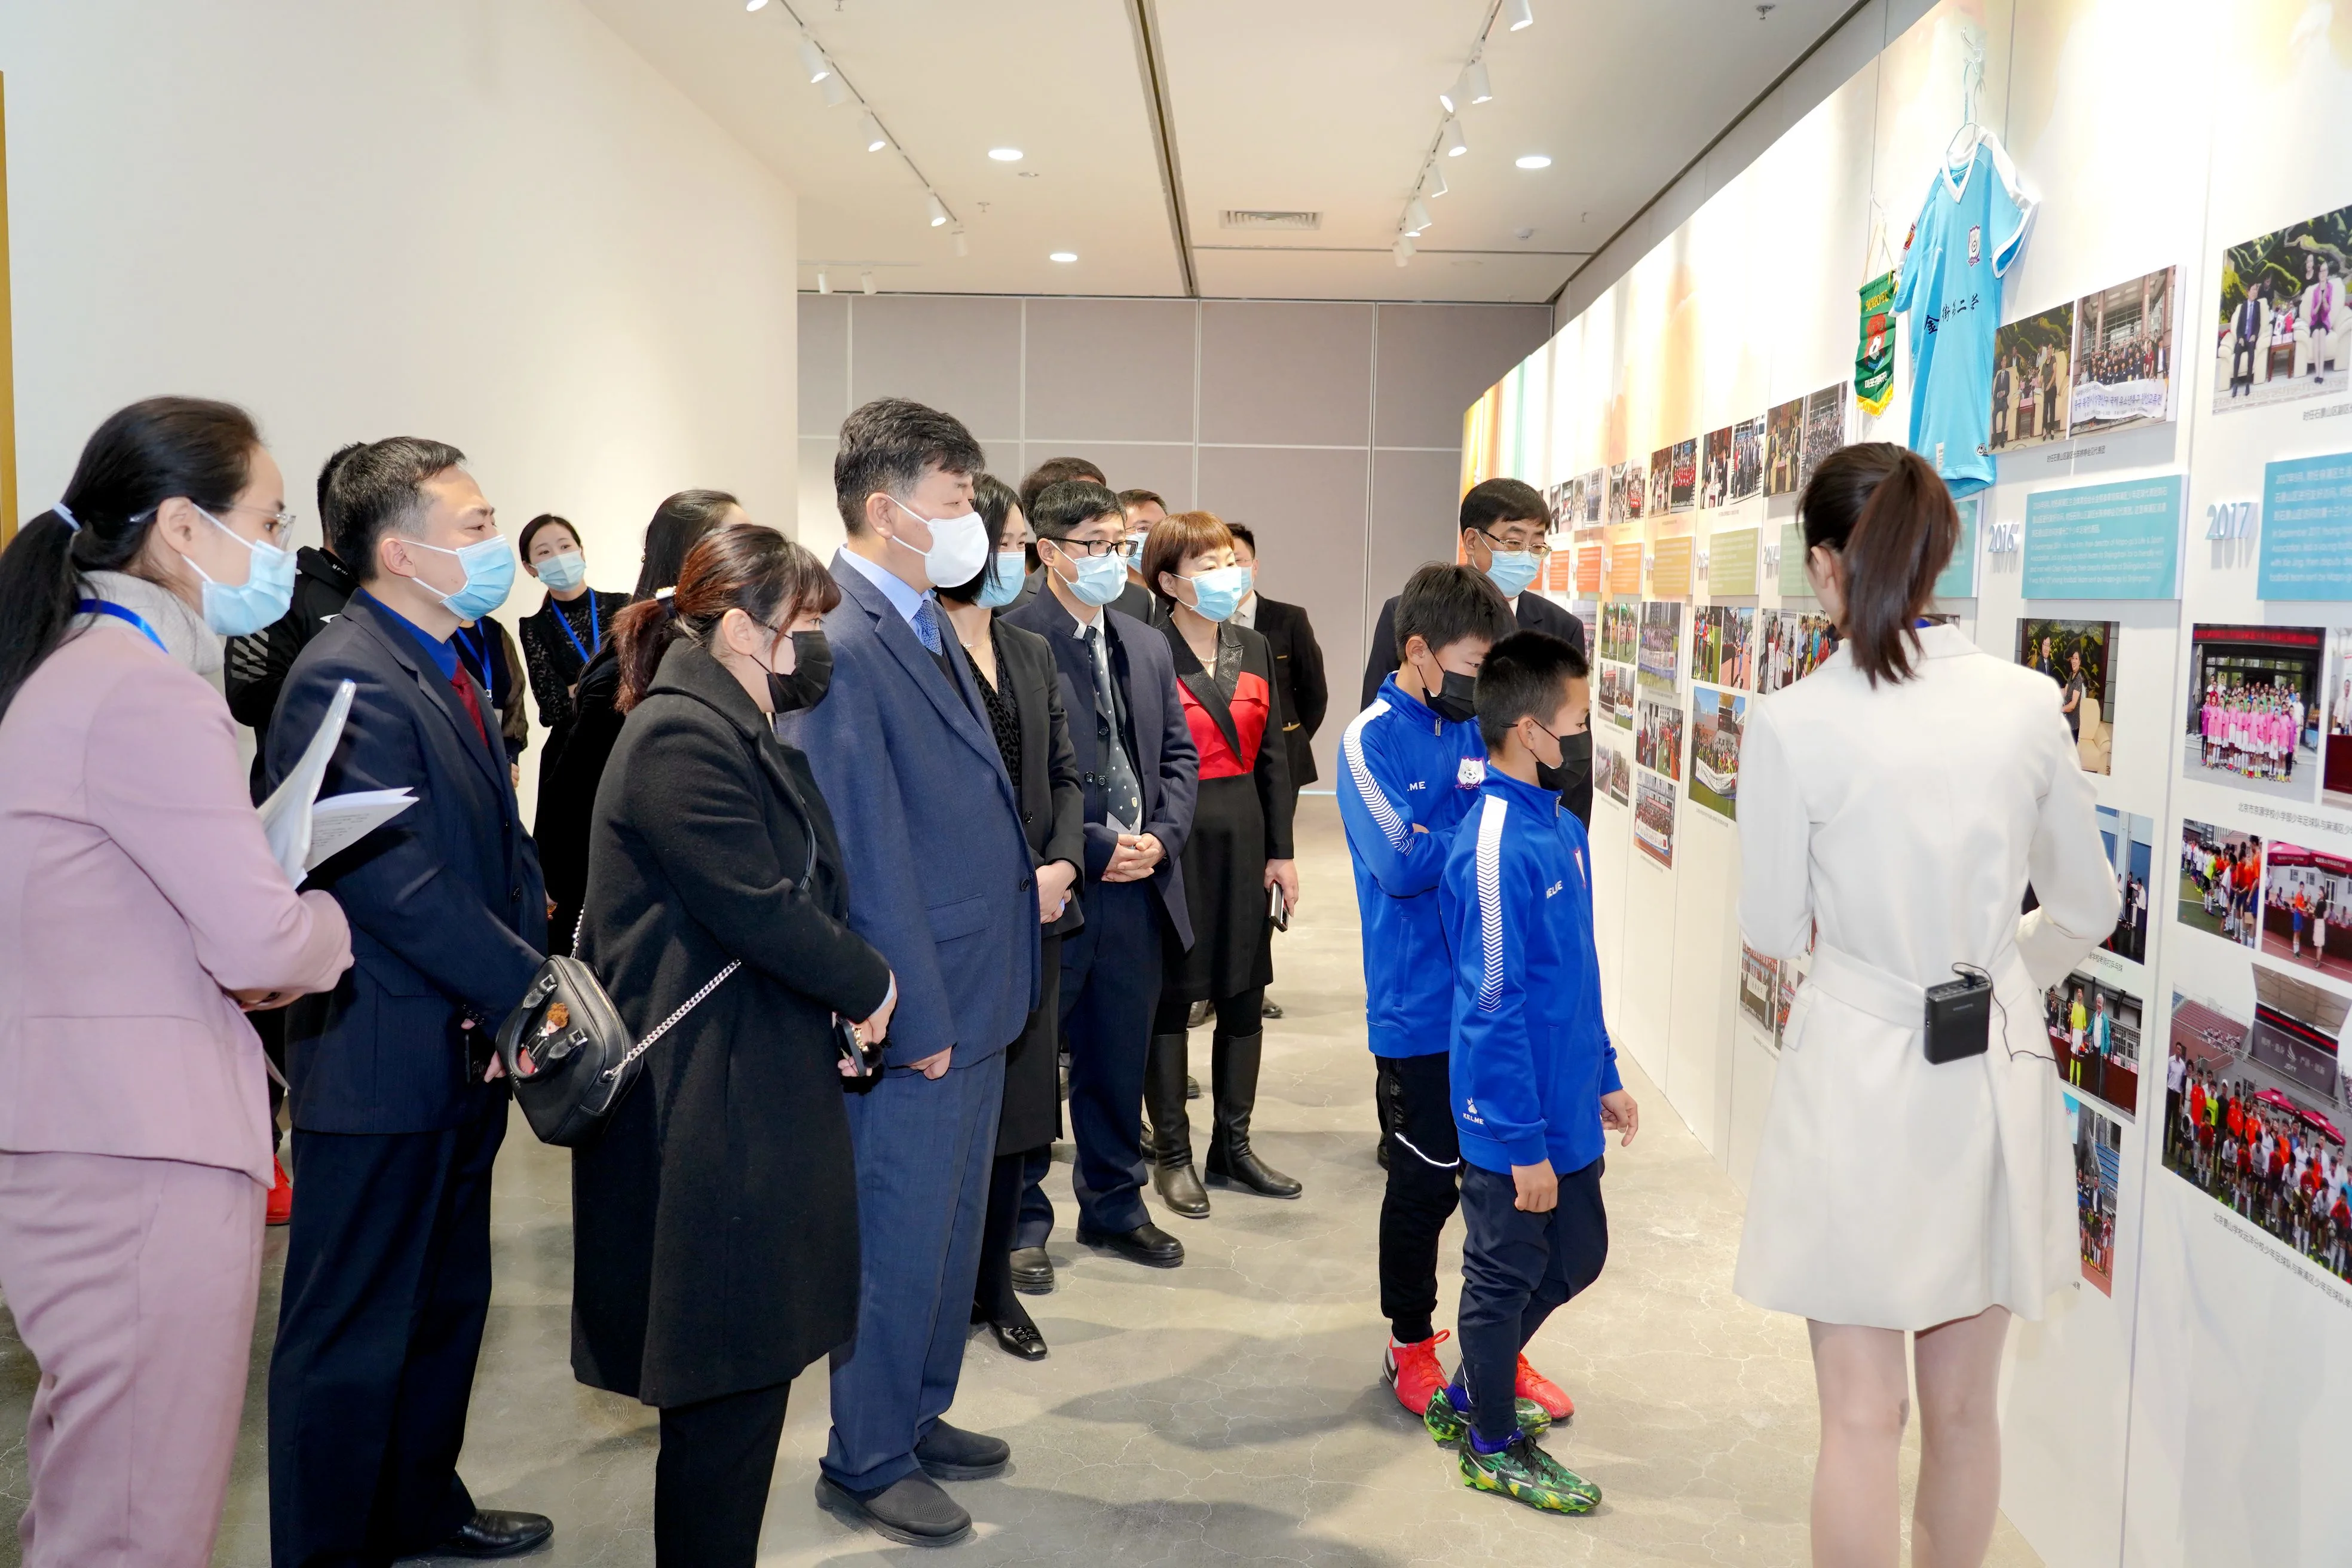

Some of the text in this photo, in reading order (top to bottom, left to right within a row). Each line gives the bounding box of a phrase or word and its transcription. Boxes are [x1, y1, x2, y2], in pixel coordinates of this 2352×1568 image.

[2205, 502, 2258, 540] 2017
[1988, 523, 2019, 553] 2016
[1463, 1112, 1484, 1125] KELME
